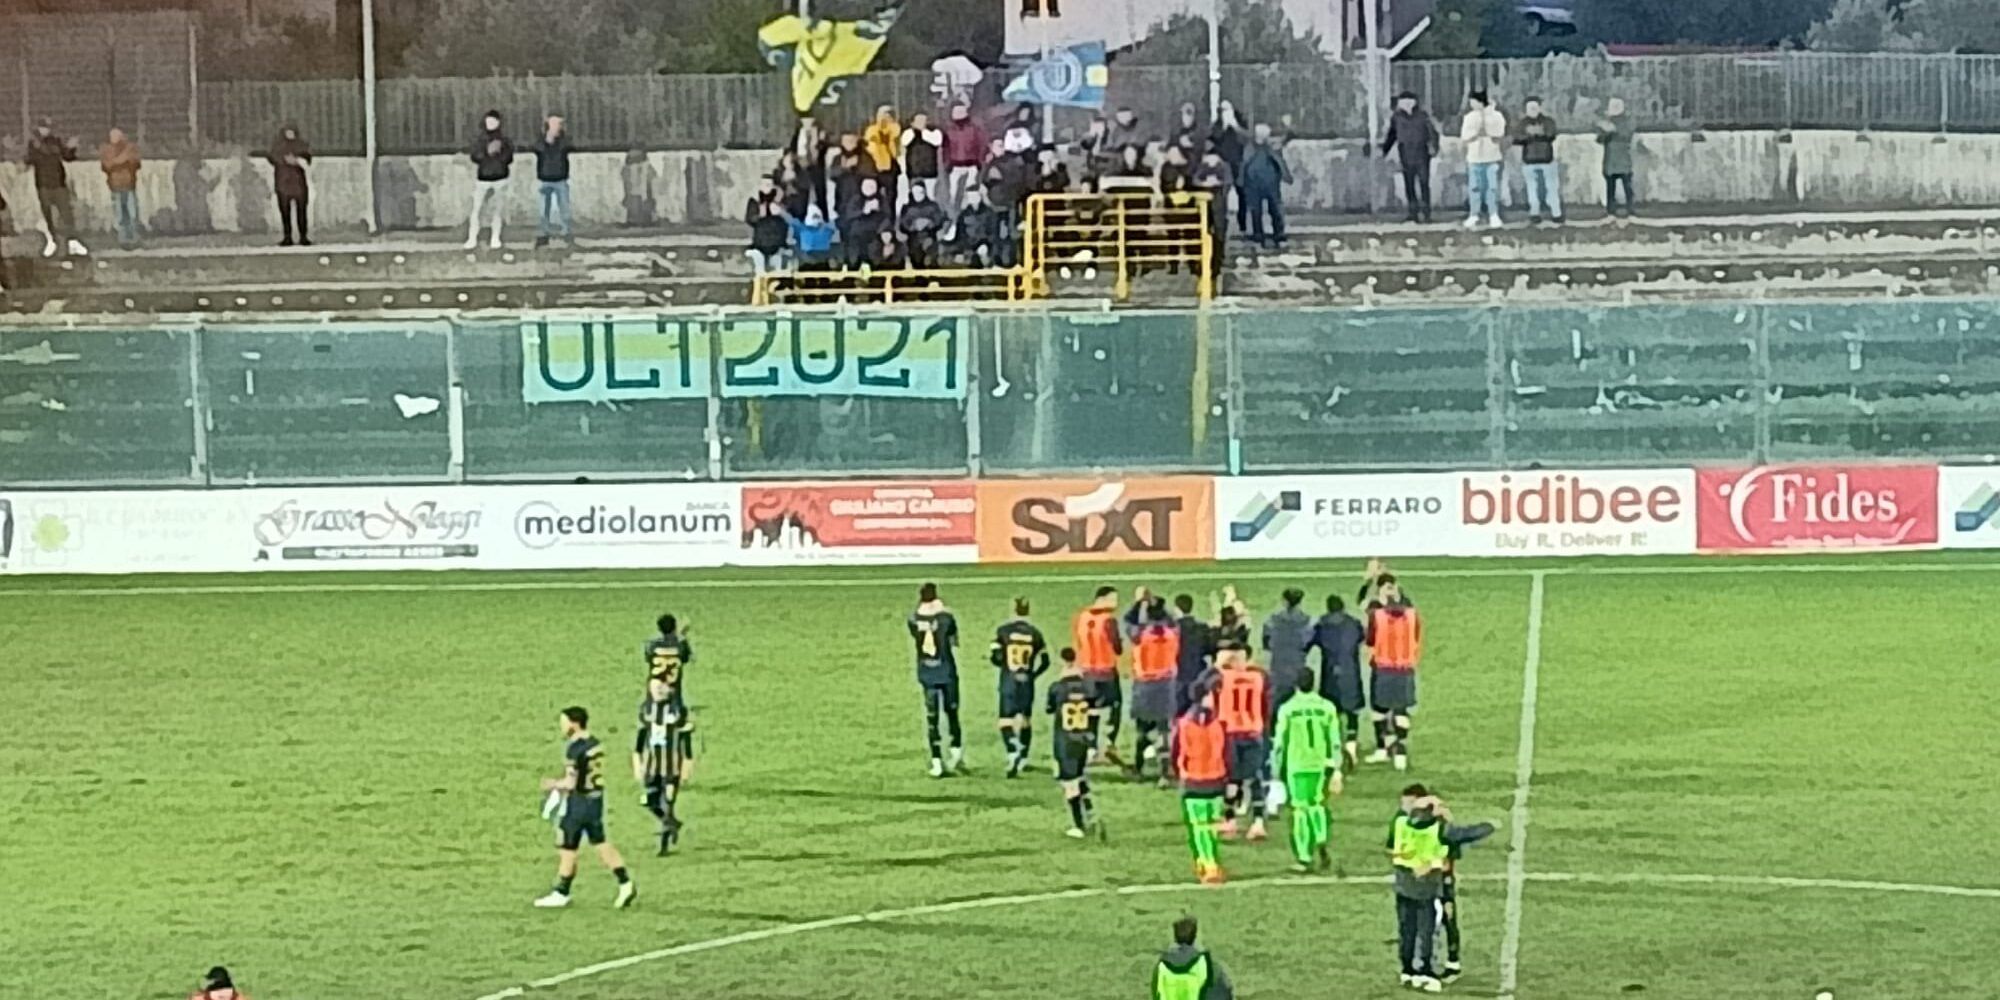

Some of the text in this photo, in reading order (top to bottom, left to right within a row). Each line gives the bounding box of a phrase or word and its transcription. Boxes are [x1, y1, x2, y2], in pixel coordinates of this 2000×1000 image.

[724, 319, 957, 390] 2021
[1314, 497, 1442, 515] FERRARO
[1463, 474, 1681, 525] bidibee
[1770, 473, 1899, 523] Fides
[524, 505, 732, 535] mediolanum
[1313, 519, 1400, 538] GROUP
[1495, 532, 1528, 549] Buy
[1560, 532, 1622, 547] Deliver
[1306, 718, 1315, 749] 1
